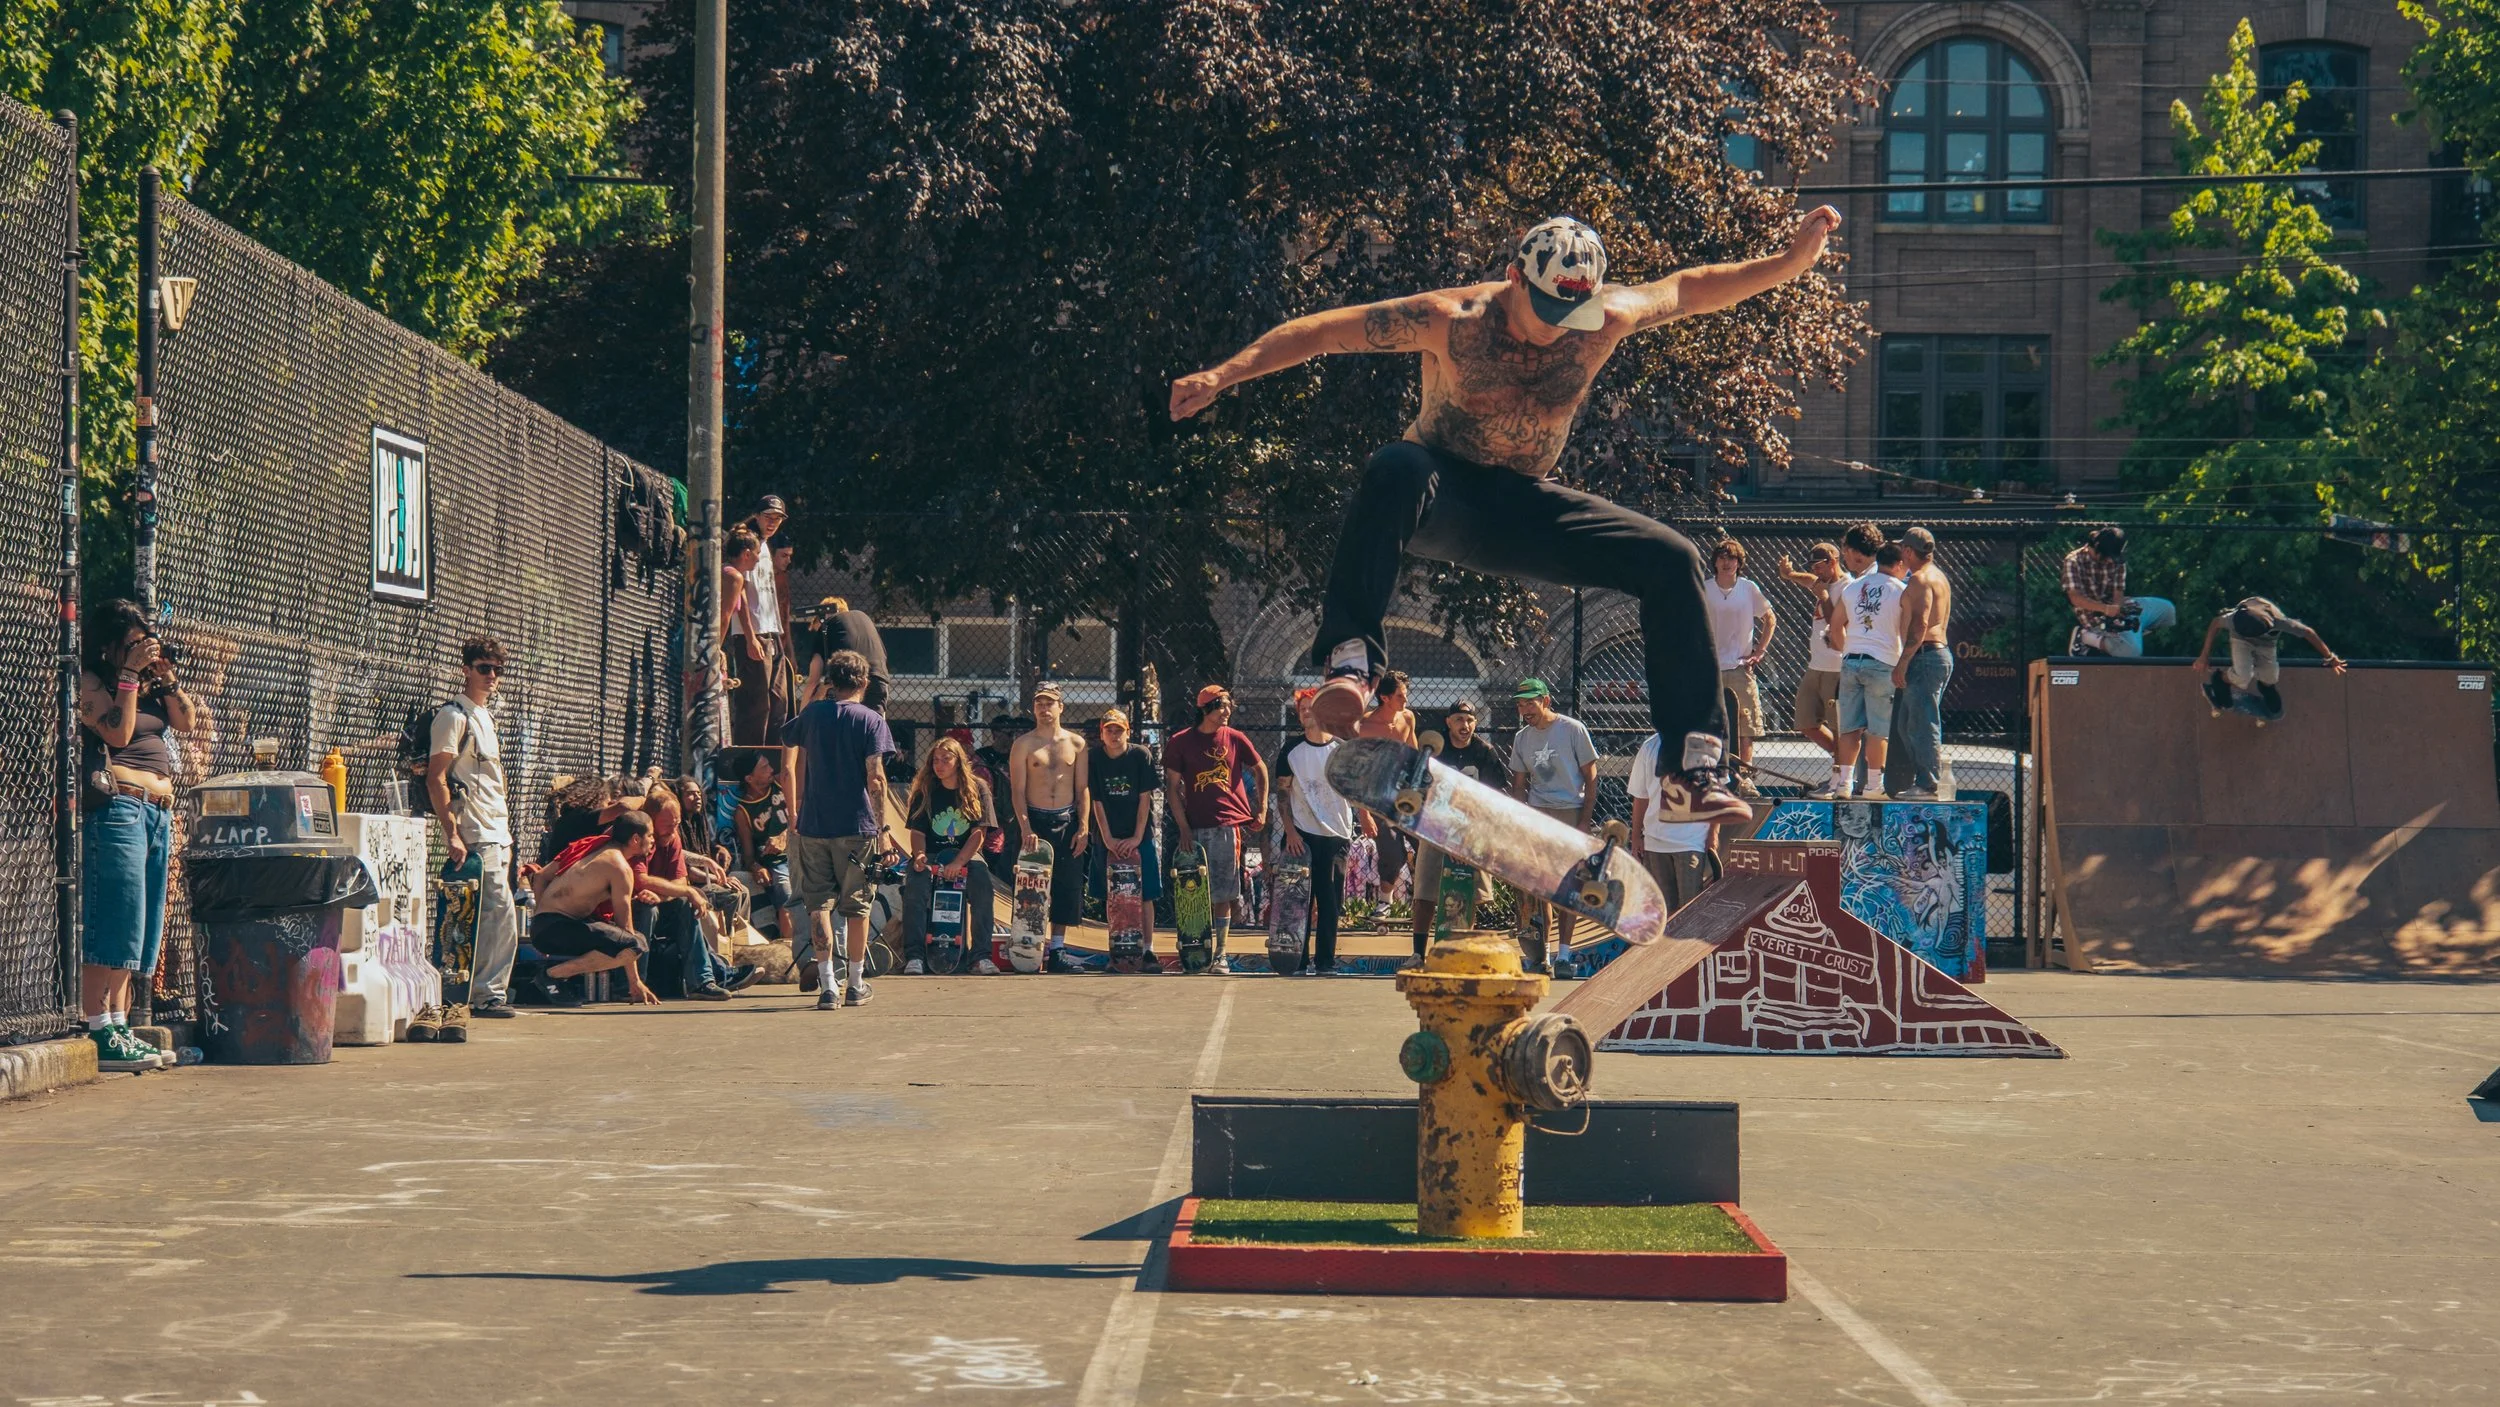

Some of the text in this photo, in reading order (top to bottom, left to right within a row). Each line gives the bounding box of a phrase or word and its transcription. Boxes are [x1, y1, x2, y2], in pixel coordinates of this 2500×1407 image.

[1782, 852, 1806, 872] HUT
[1808, 848, 1839, 858] POPS
[1017, 876, 1050, 889] HOCKEY
[1783, 903, 1813, 922] POPS
[1750, 933, 1870, 977] EVERETT CRUST
